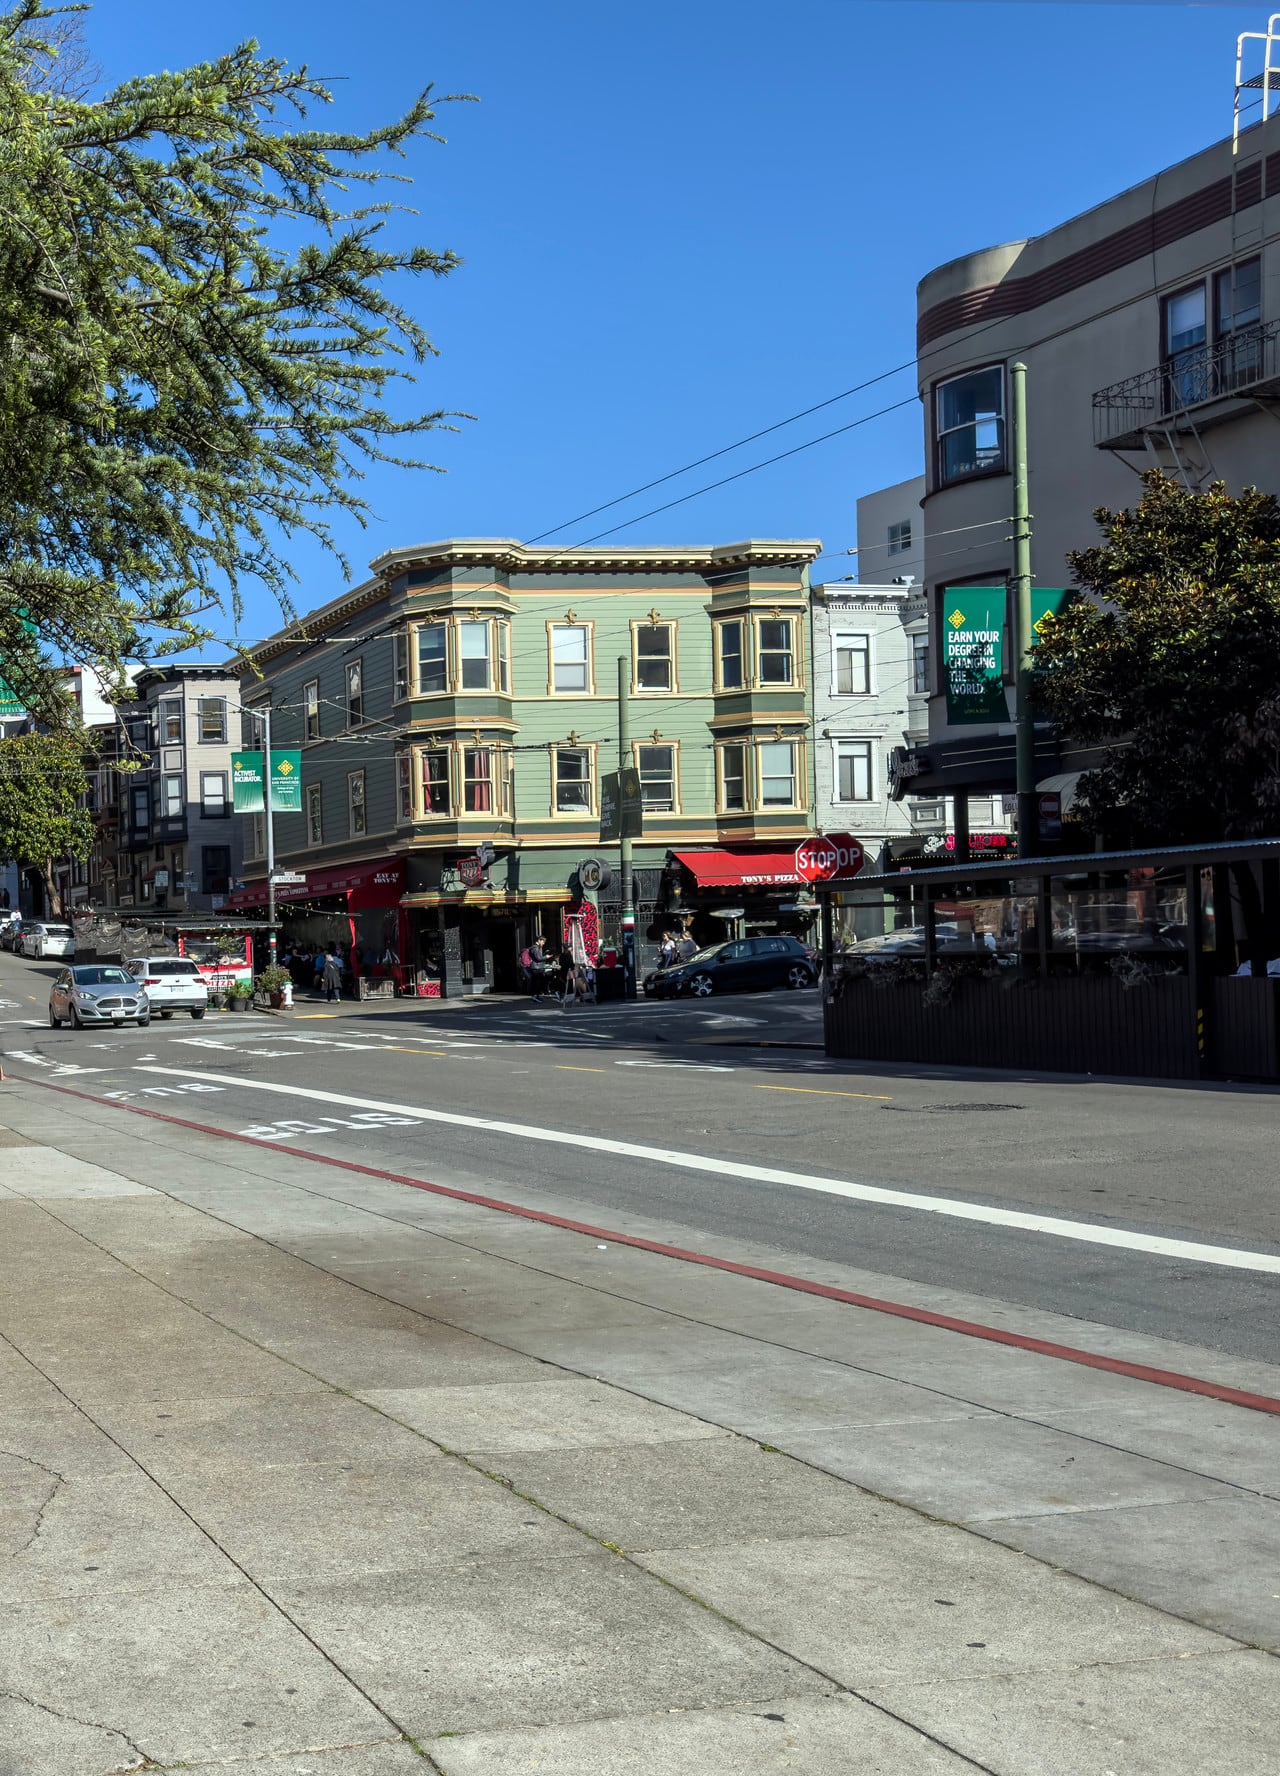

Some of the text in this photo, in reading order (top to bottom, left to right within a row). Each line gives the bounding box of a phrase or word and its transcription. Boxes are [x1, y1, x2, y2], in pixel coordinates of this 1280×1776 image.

[948, 631, 999, 643] EARN YOUR
[948, 644, 993, 656] DEGREE IN
[949, 657, 996, 669] CHANGING
[949, 670, 967, 682] THE
[799, 851, 836, 869] STOP
[839, 848, 860, 866] OP
[741, 874, 799, 883] TONY'S PIZZA
[237, 1112, 424, 1140] STOP
